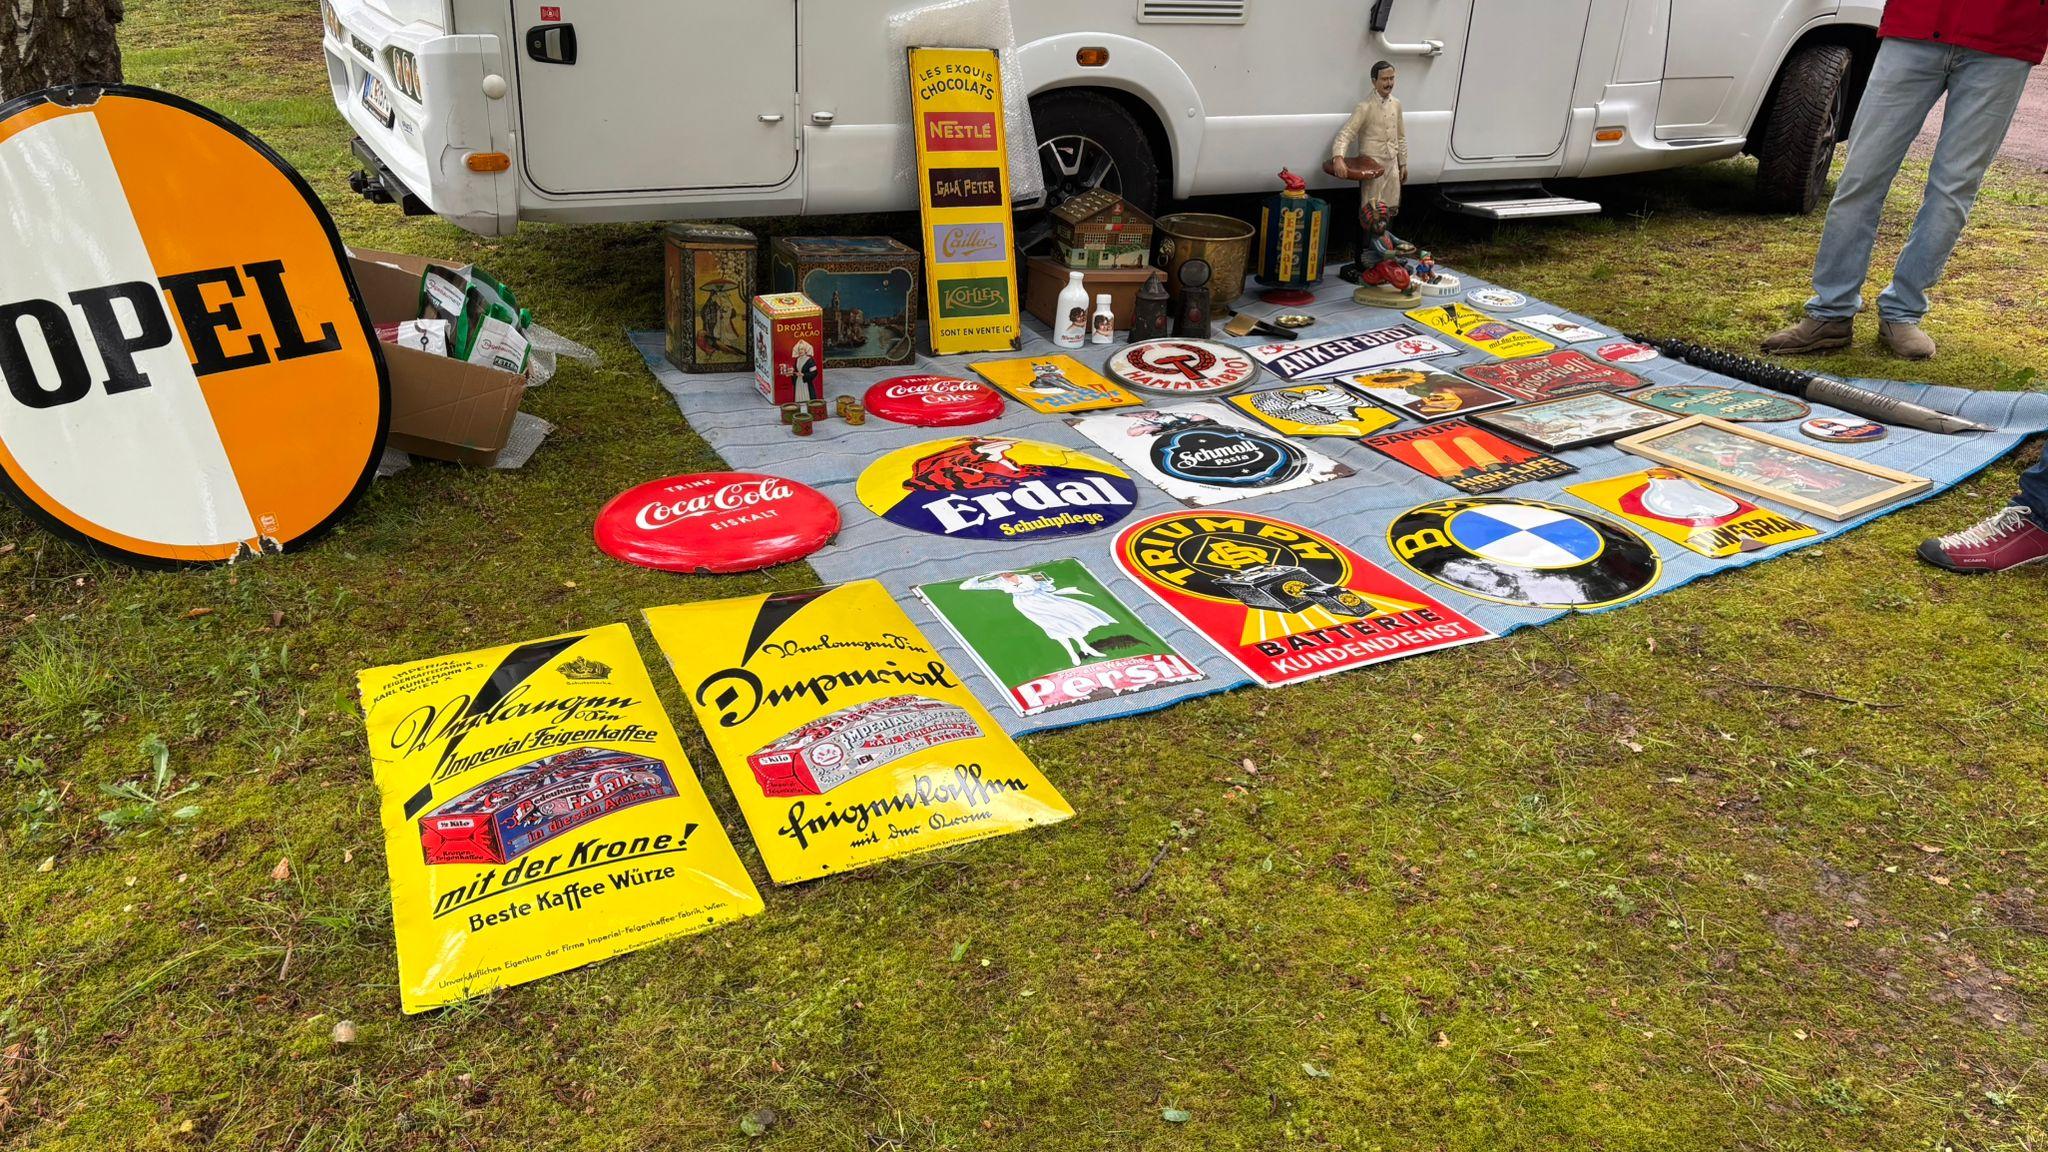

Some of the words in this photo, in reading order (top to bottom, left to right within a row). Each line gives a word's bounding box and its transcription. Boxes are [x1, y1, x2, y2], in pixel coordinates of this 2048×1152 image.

[919, 66, 941, 82] LES
[945, 64, 993, 82] EXQUIS
[920, 78, 994, 100] CHOCOLATS
[929, 120, 992, 139] NESTLÉ
[964, 179, 996, 197] PETER
[943, 285, 1005, 311] KOHLER
[0, 259, 343, 410] OPEL
[776, 321, 813, 332] DROSTE
[793, 329, 820, 338] CACAO
[940, 329, 960, 337] SONT
[976, 326, 1000, 334] VENTE
[1002, 325, 1012, 333] ICI
[1123, 356, 1249, 391] HAMMERBROT
[885, 380, 980, 398] Coca-Cola
[921, 394, 976, 404] Coke
[1367, 420, 1467, 448] SAMUM
[1177, 440, 1260, 468] Schmoll
[1214, 454, 1250, 466] Pasta
[663, 478, 716, 493] TRINK
[1451, 456, 1562, 489] HIGH-LIFE
[1466, 464, 1573, 493] SUPERFILTER
[635, 477, 794, 530] Coca-Cola
[921, 476, 1133, 534] Erdal
[710, 509, 780, 532] EISKALT
[999, 511, 1105, 536] Schuhpflege
[1140, 517, 1334, 587] TRIUMPH
[1255, 608, 1444, 658] BATTERIE
[1269, 621, 1469, 675] KUNDENDIENST
[392, 660, 457, 680] IMPERIAL
[1017, 654, 1198, 709] Persil
[373, 689, 398, 703] KARL
[399, 668, 462, 692] KUHLEMANN
[405, 679, 439, 693] WIEN
[840, 712, 914, 751] IMPERIAL
[868, 737, 899, 748] KARL
[437, 724, 659, 781] Imperial-Feigenkaffee
[768, 755, 790, 763] Kilo
[856, 754, 875, 766] IEN
[514, 782, 591, 823] Bedeutendste
[565, 773, 638, 811] FABRIK
[449, 819, 471, 828] Kilo
[527, 827, 545, 843] in
[549, 804, 601, 832] diesem
[850, 829, 881, 848] mit
[432, 868, 496, 915] mit
[501, 852, 563, 887] der
[567, 823, 699, 868] Krone!
[468, 903, 532, 933] Beste
[536, 881, 606, 912] Kaffee
[608, 865, 676, 890] Würze
[504, 953, 543, 969] Eigentum
[545, 948, 560, 957] der
[561, 942, 585, 952] Firma
